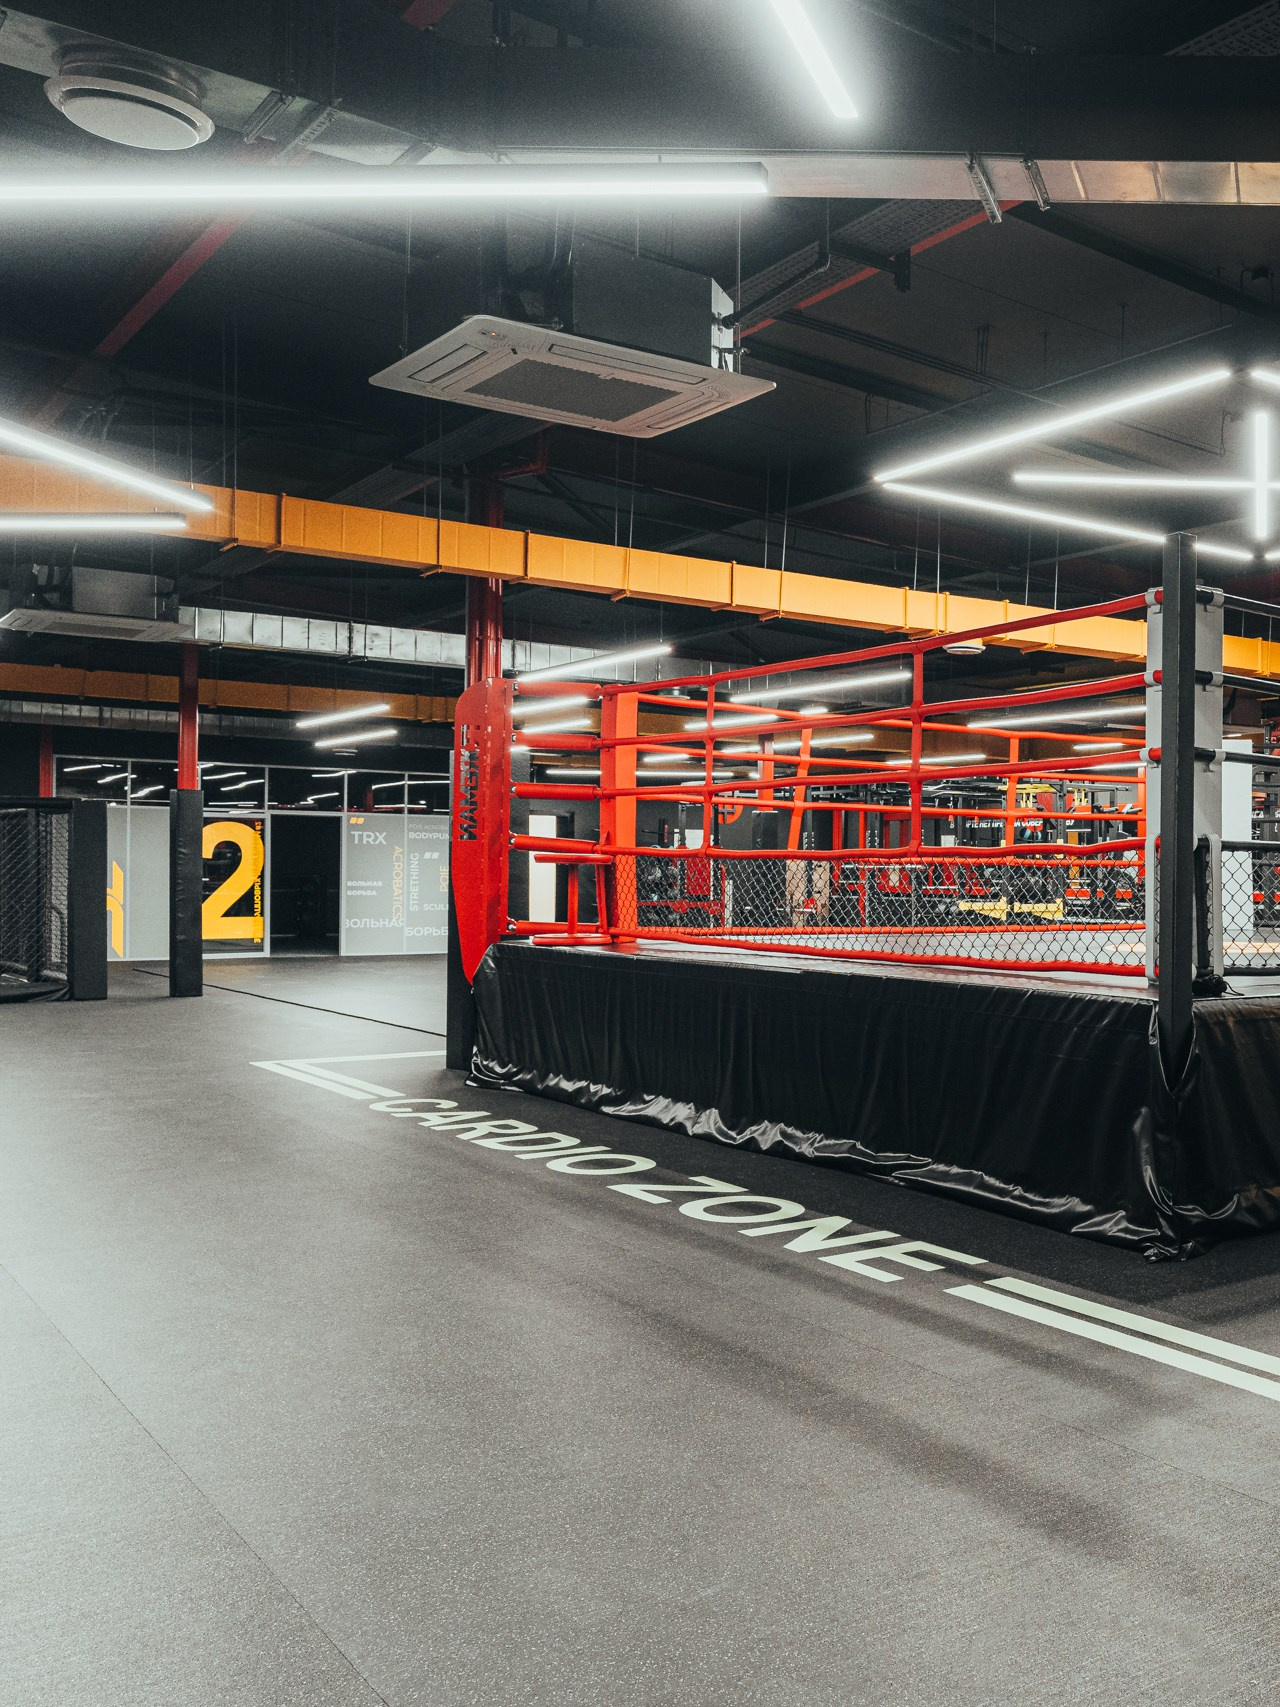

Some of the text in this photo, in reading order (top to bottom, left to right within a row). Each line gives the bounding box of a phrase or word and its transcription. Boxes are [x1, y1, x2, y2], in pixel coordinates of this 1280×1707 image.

[350, 831, 387, 845] TRX
[408, 832, 449, 840] BODYPU
[202, 821, 265, 940] 2
[393, 846, 403, 920] ACROBATICS
[410, 852, 419, 911] STRETHING
[405, 927, 449, 937] БОРЬБ
[369, 1098, 990, 1283] CARDIO ZONE
